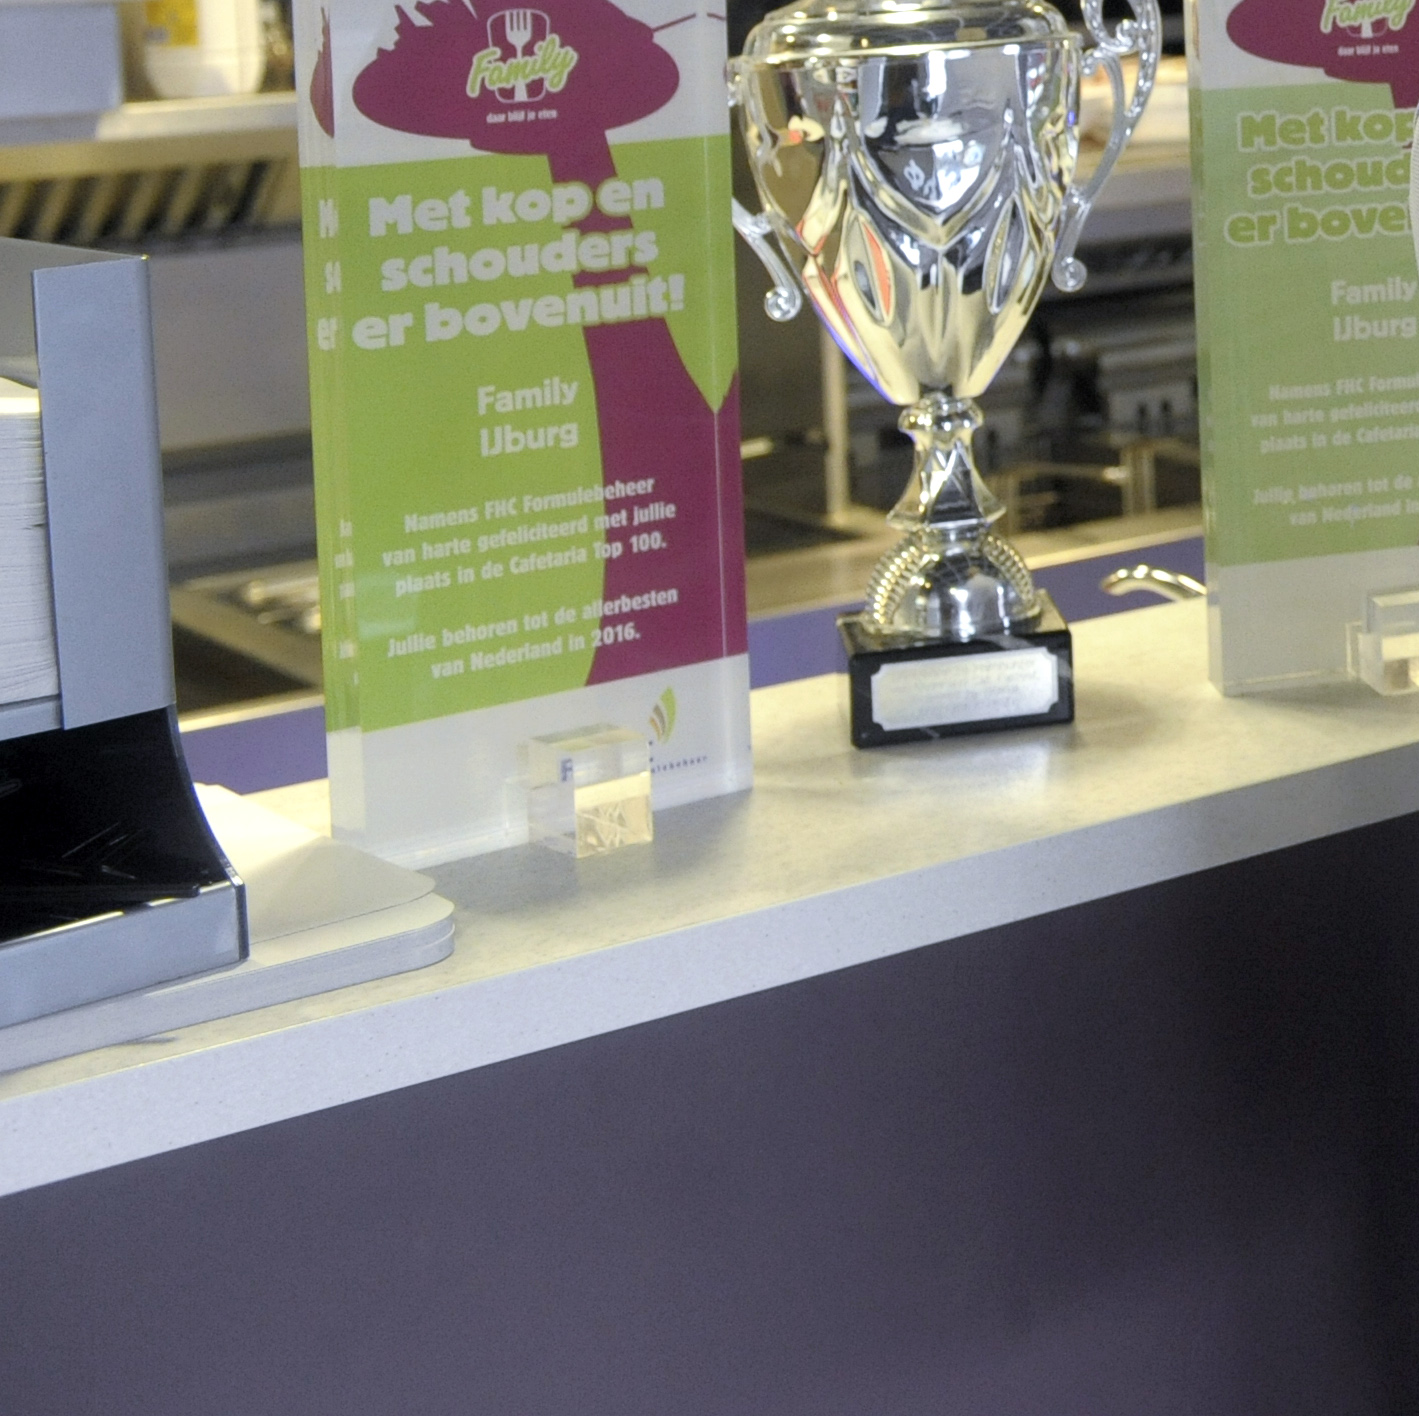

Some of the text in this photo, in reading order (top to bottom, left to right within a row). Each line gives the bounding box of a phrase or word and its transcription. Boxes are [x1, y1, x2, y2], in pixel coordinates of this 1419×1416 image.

[466, 34, 579, 98] Family
[1238, 109, 1327, 152] Met
[1248, 152, 1410, 198] schoud
[369, 178, 665, 236] Met kop en
[1224, 211, 1281, 246] er
[382, 230, 658, 291] schouders
[352, 274, 685, 350] er bovenuit!
[477, 378, 578, 415] Family
[1251, 413, 1277, 428] van
[1283, 406, 1324, 424] harte
[1269, 383, 1330, 401] Namens
[480, 422, 579, 457] IJburg
[1260, 435, 1306, 454] plaats
[1313, 433, 1327, 448] in
[1332, 431, 1351, 446] de
[404, 478, 654, 534] Namens FHC Formulebeheer
[1395, 473, 1413, 490] de
[383, 502, 676, 568] van harte gefeliciteerd met jullie
[395, 531, 666, 598] plaats in de Cafetaria Top 100.
[388, 588, 678, 657] Jullie behoren tot de allerbesten
[431, 622, 640, 679] van Nederland in 2016.
